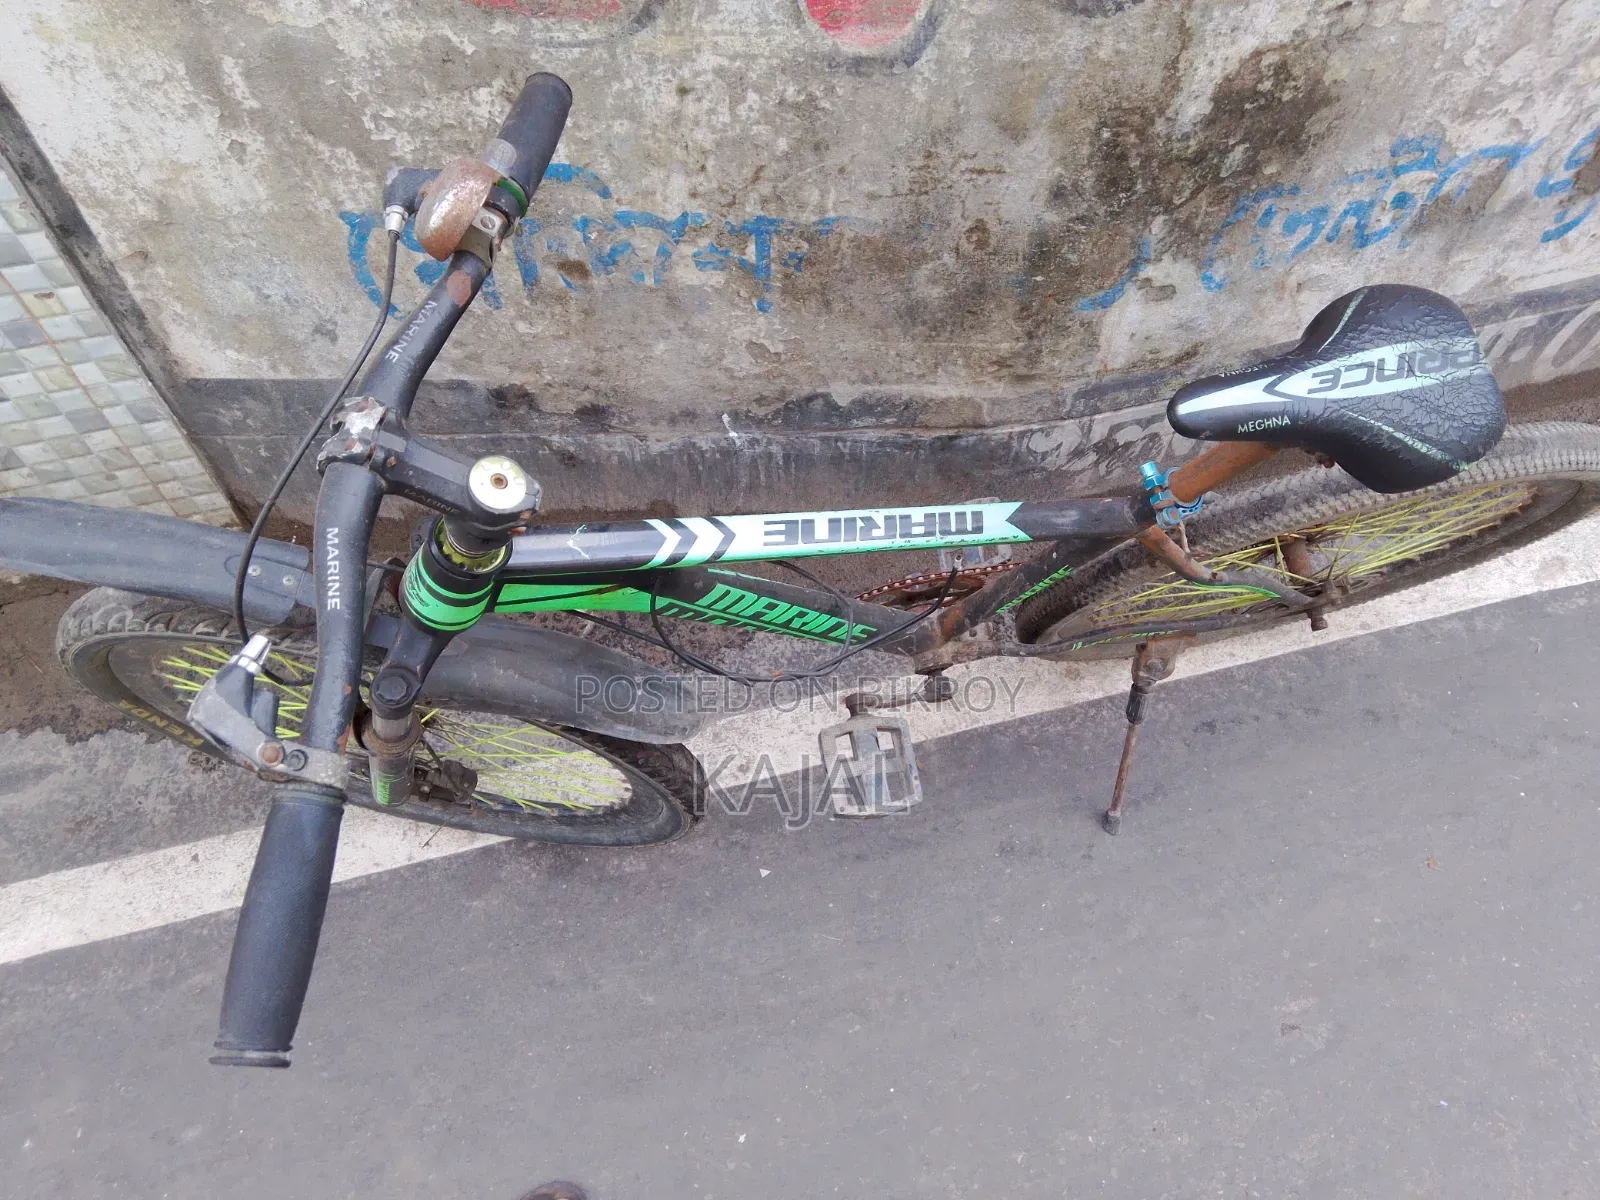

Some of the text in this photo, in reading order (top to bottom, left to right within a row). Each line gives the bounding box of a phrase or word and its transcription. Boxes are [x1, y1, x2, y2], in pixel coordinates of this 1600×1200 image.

[384, 300, 438, 363] MARINE
[1307, 341, 1480, 395] PRINCE
[1237, 414, 1292, 434] MEGHNA
[763, 510, 984, 547] MARINE
[326, 527, 341, 611] MARINE
[694, 582, 879, 644] MARINE
